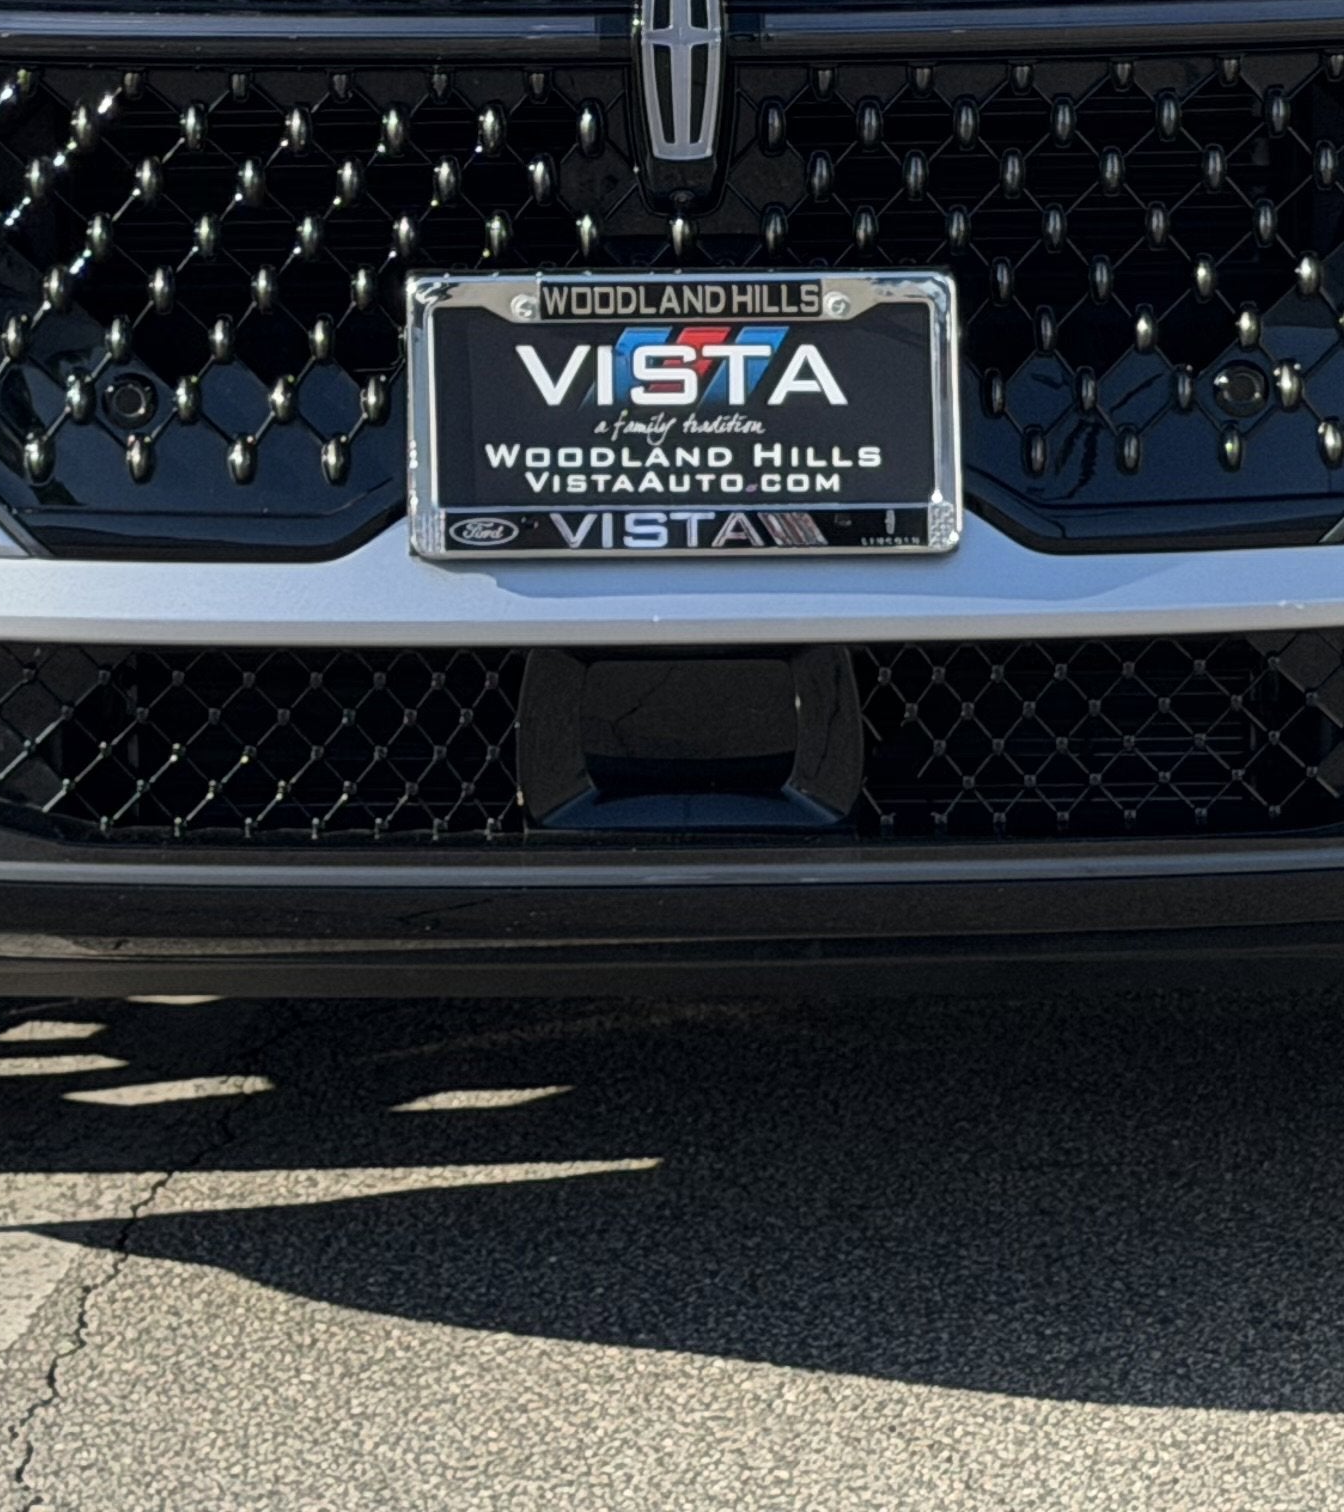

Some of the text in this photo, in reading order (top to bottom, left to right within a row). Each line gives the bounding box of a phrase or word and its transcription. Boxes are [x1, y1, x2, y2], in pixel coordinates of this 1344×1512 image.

[542, 283, 822, 316] WOODLAND HILLS
[515, 344, 849, 407] VISTA
[594, 412, 766, 445] a family tradition
[485, 443, 882, 469] WOODLAND HILLS
[462, 522, 505, 540] Ford
[549, 512, 765, 549] VISTA
